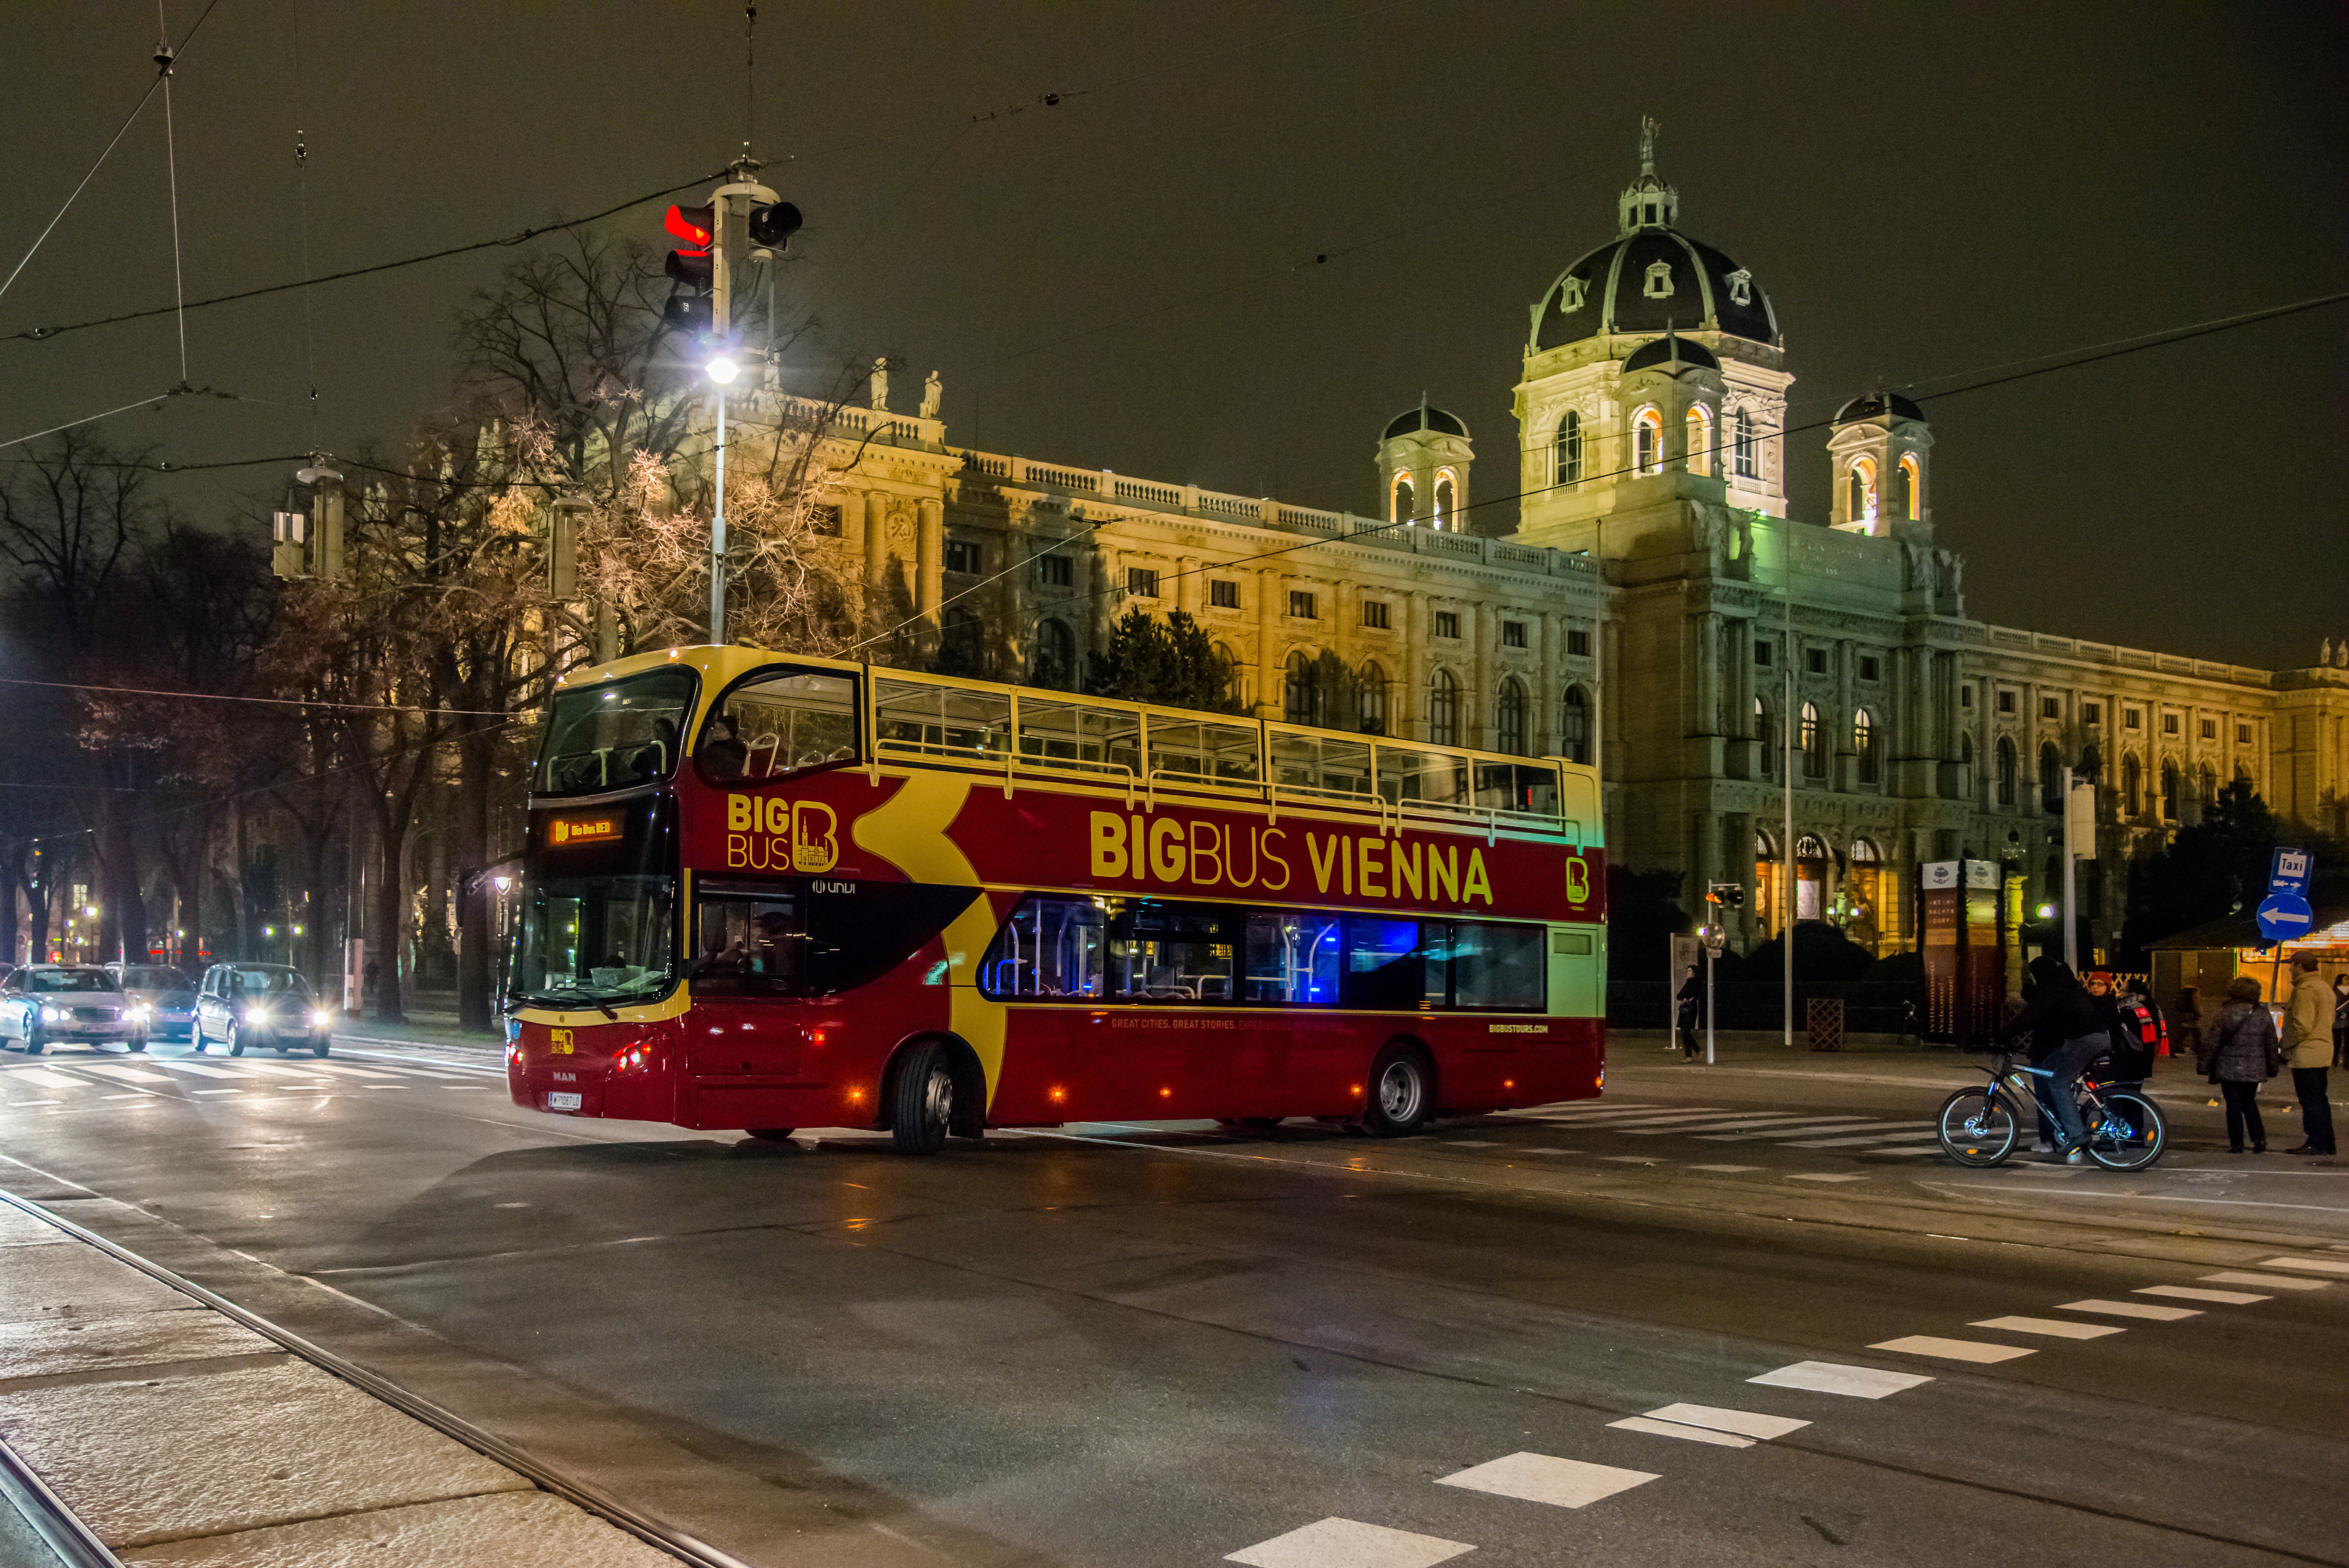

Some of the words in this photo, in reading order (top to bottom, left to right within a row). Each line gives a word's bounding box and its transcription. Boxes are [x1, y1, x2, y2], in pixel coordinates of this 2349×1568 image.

[728, 794, 790, 834] BIG
[728, 834, 790, 871] BUS
[1306, 832, 1493, 905] VIENNA
[2282, 858, 2303, 871] Taxi
[1111, 1018, 1139, 1028] GREAT
[1141, 1019, 1170, 1029] CITIES.
[1172, 1019, 1199, 1029] GREAT
[1201, 1020, 1236, 1030] STORIES.
[1489, 1024, 1548, 1034] BIGBUSTOURS.COM
[551, 1029, 564, 1042] BIG
[552, 1042, 564, 1054] BUS
[553, 1072, 576, 1082] MAN
